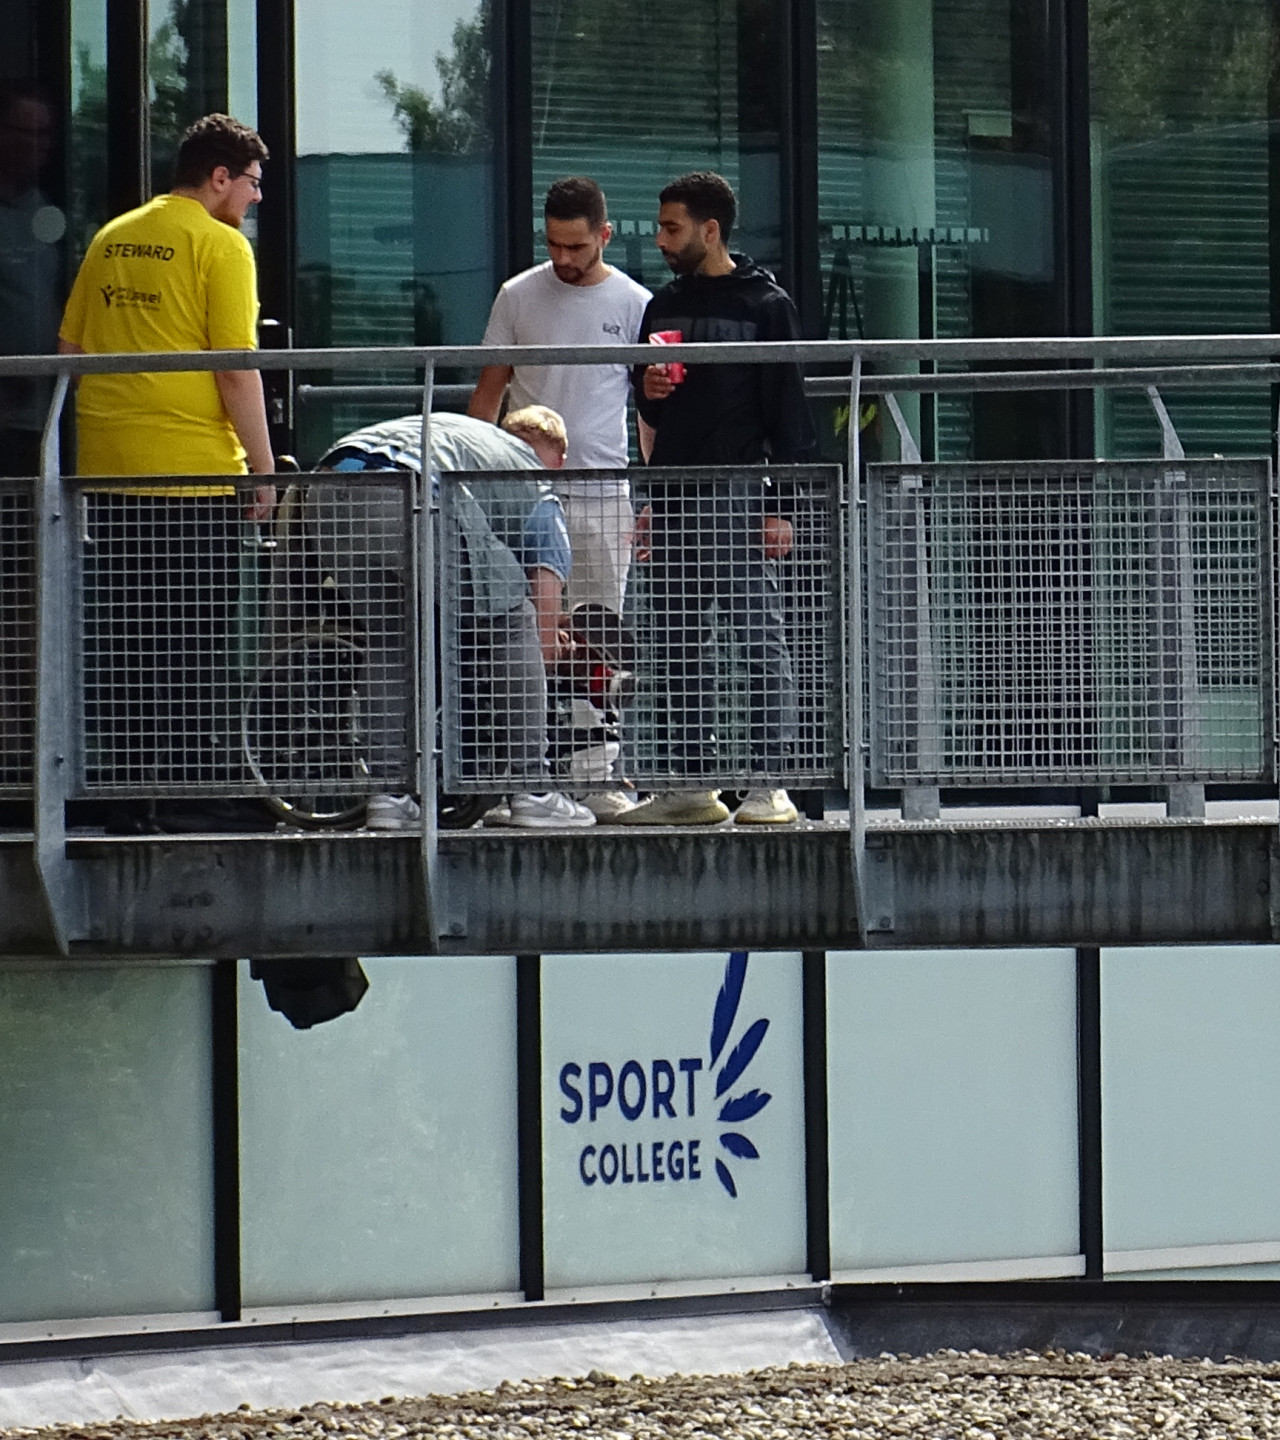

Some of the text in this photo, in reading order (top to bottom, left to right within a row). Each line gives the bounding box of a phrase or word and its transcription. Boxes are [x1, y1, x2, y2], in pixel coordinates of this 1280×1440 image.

[104, 243, 175, 261] STEWARD
[559, 1057, 703, 1124] SPORT
[579, 1139, 702, 1186] COLLEGE
